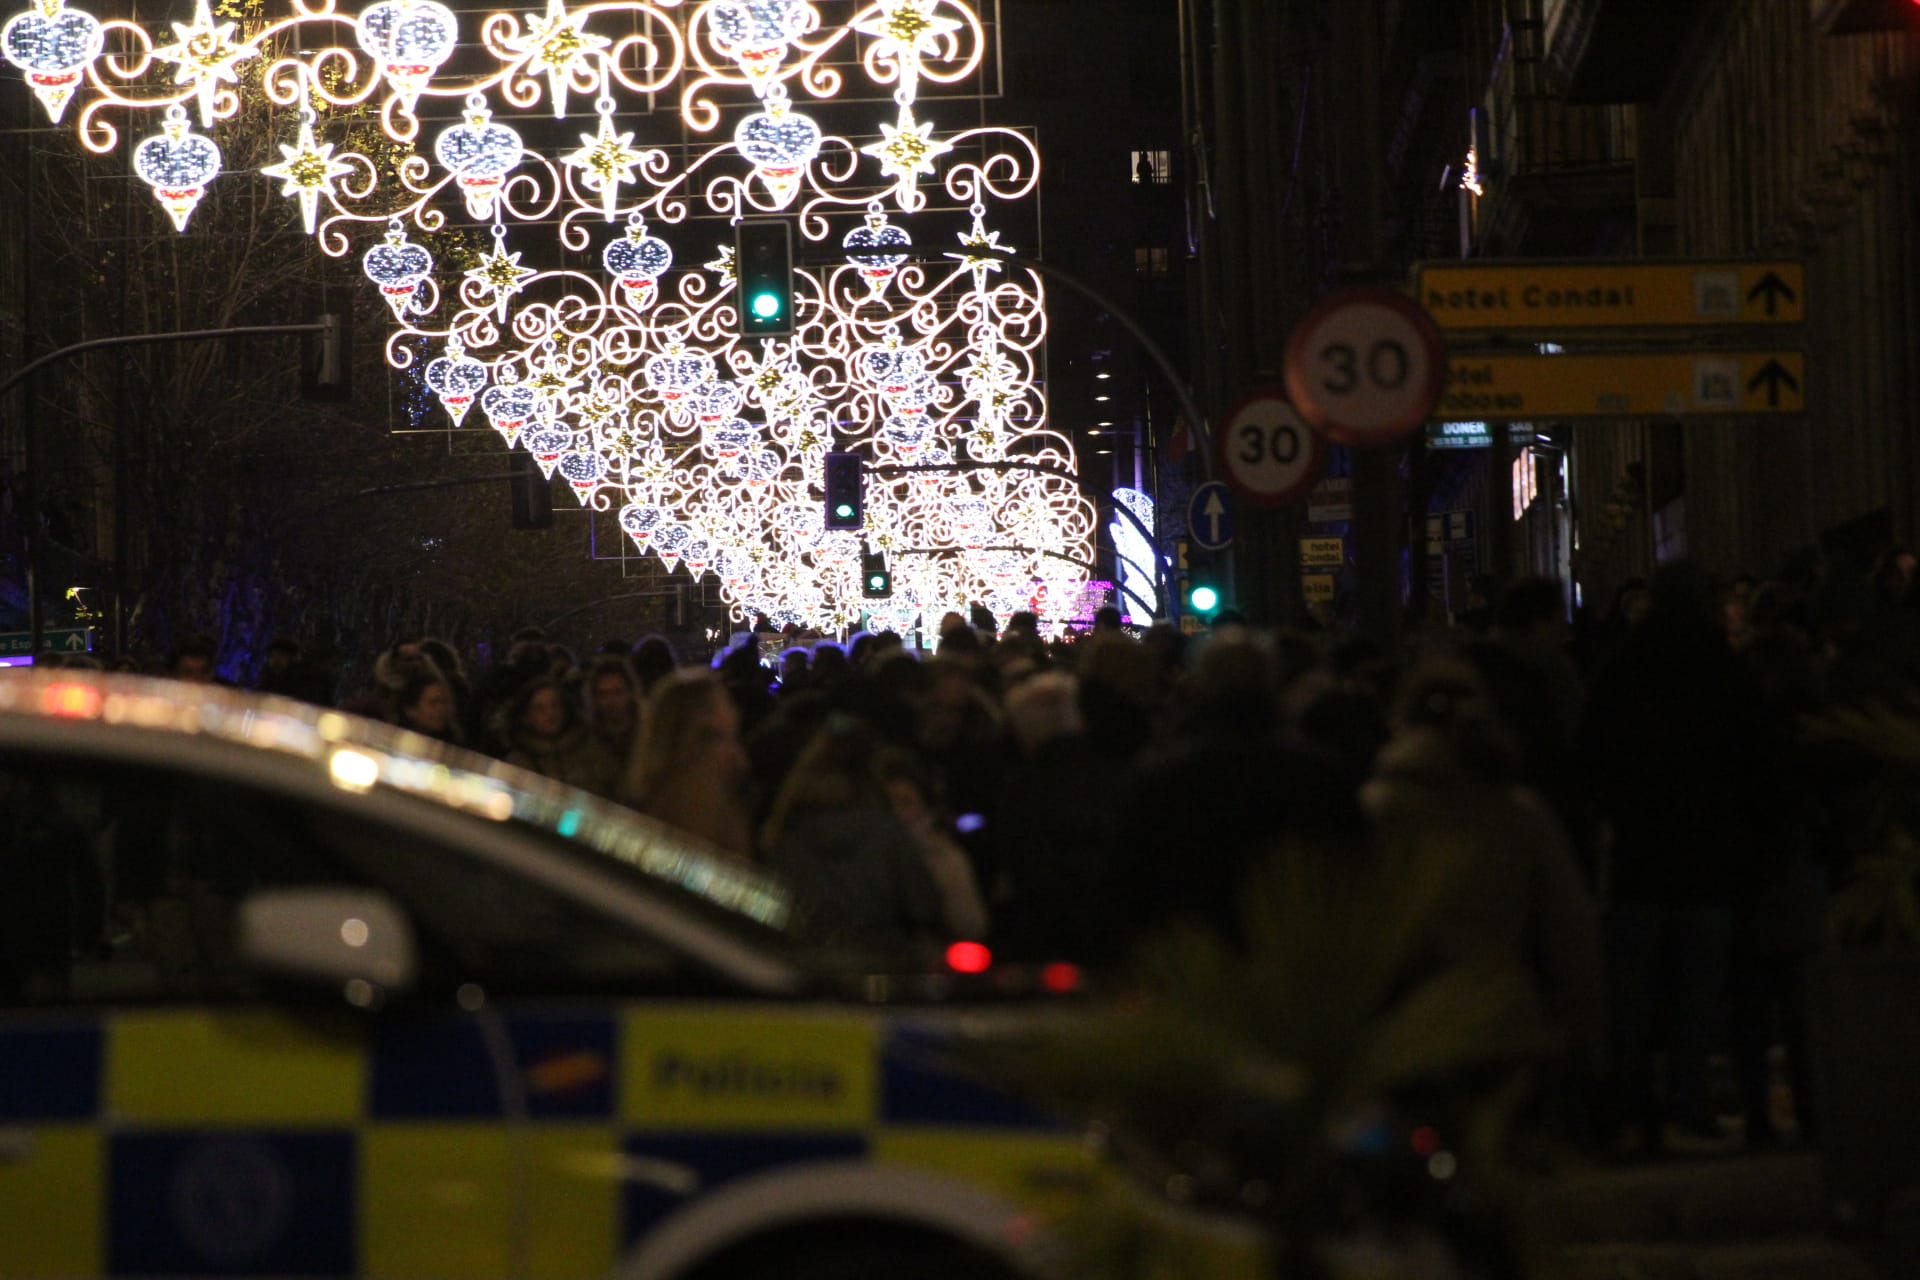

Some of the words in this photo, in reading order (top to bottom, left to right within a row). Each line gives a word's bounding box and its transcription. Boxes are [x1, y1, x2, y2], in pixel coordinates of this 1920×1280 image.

[1427, 286, 1508, 309] hotel
[1524, 284, 1634, 308] Condal
[1320, 339, 1408, 395] 30
[1239, 425, 1299, 464] 30
